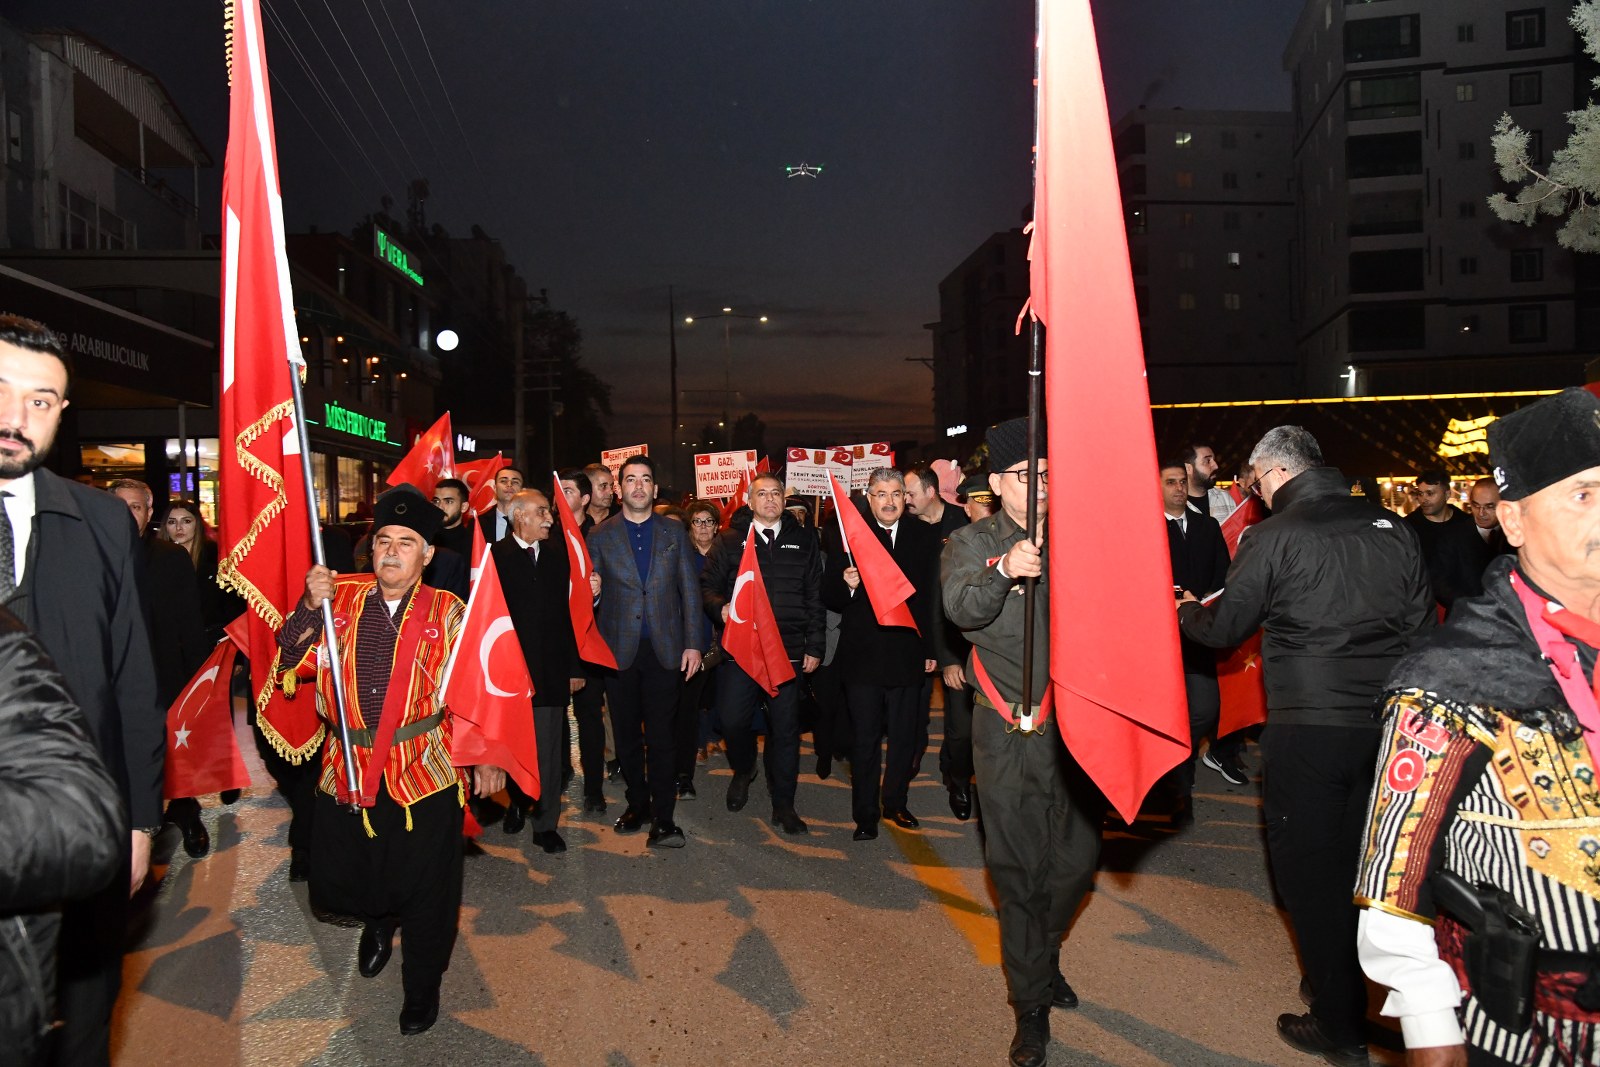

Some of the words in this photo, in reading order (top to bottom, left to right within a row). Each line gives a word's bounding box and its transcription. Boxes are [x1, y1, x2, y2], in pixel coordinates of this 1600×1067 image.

[387, 241, 407, 272] VERA
[71, 333, 149, 371] ARABULUCULUK
[699, 471, 719, 481] VATAN
